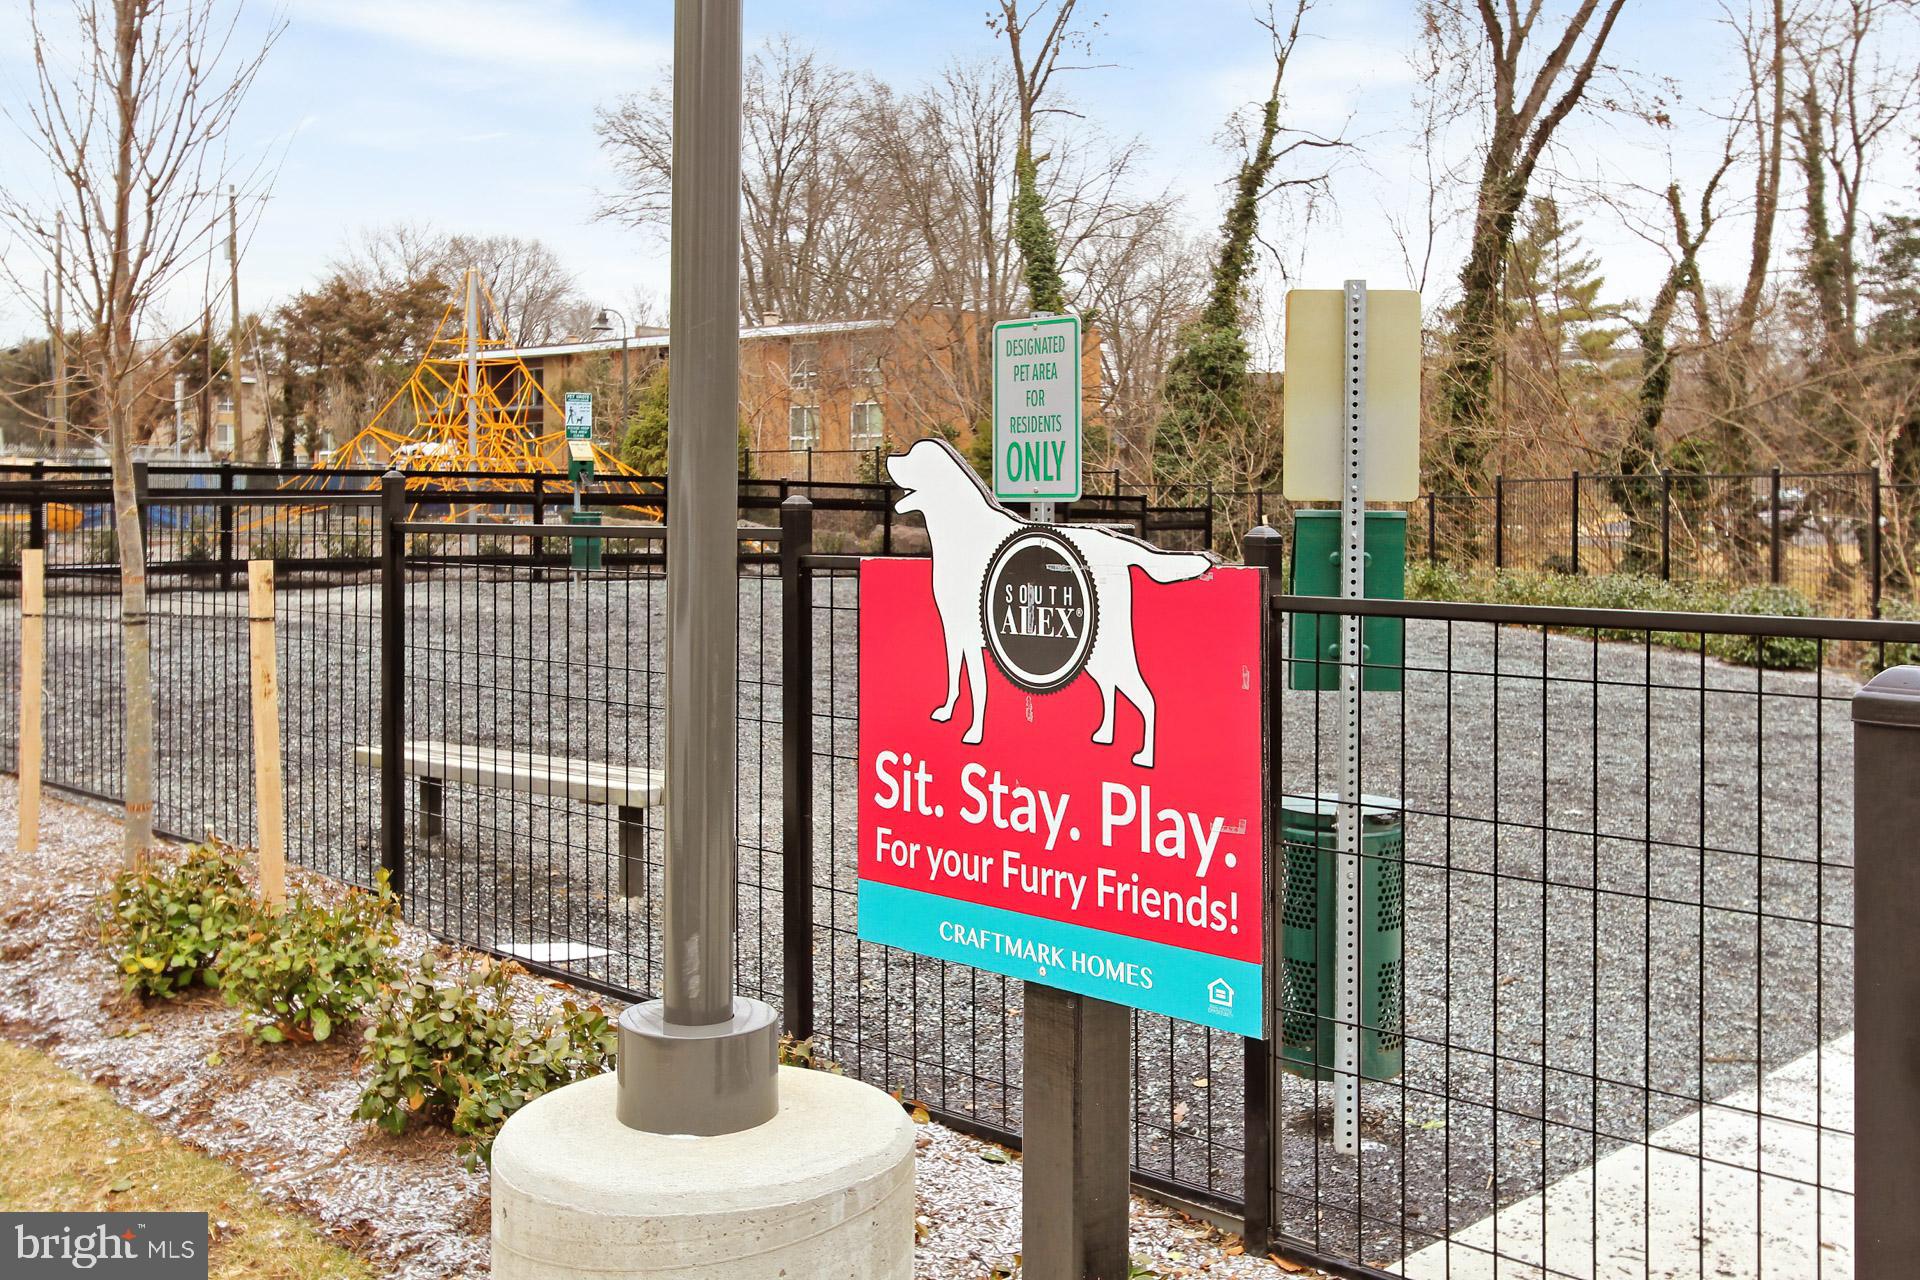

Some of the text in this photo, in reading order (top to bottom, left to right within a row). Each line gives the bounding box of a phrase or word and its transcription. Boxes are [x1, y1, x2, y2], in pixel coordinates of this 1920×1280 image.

[1006, 335, 1065, 357] DESIGNATED
[1013, 362, 1058, 382] PET AREA
[1026, 389, 1045, 407] FOR
[1010, 415, 1062, 434] RESIDENTS
[1006, 440, 1066, 482] ONLY
[1005, 584, 1073, 606] SOUTH
[874, 750, 1238, 878] Sit. Stay. Play.
[876, 827, 1239, 935] For your Furry Friends!
[938, 920, 1153, 990] CRAFTMARK HOMES
